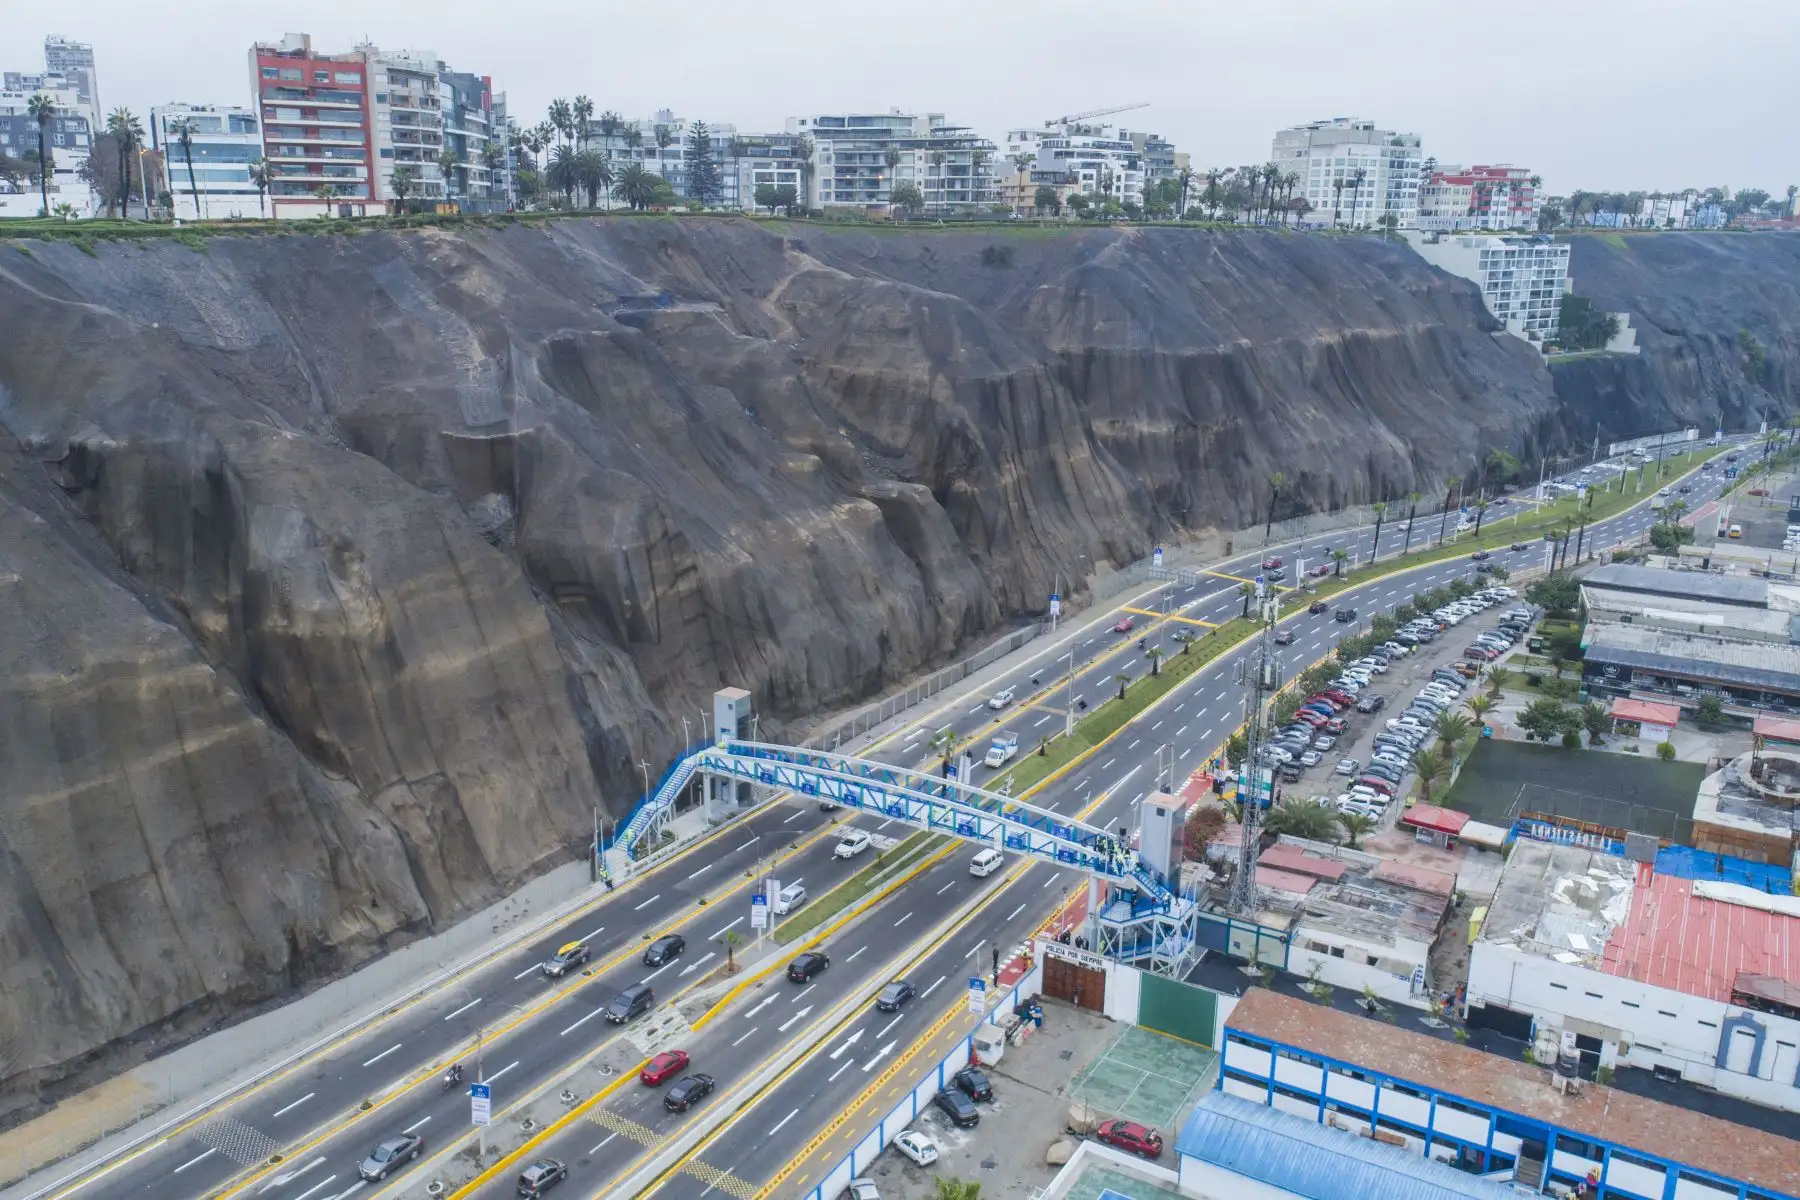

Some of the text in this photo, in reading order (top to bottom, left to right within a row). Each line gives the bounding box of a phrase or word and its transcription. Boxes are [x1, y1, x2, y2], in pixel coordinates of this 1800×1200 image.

[1045, 944, 1065, 956] POLICIA
[1067, 950, 1078, 959] POR
[1081, 954, 1103, 967] SIEMPRE
